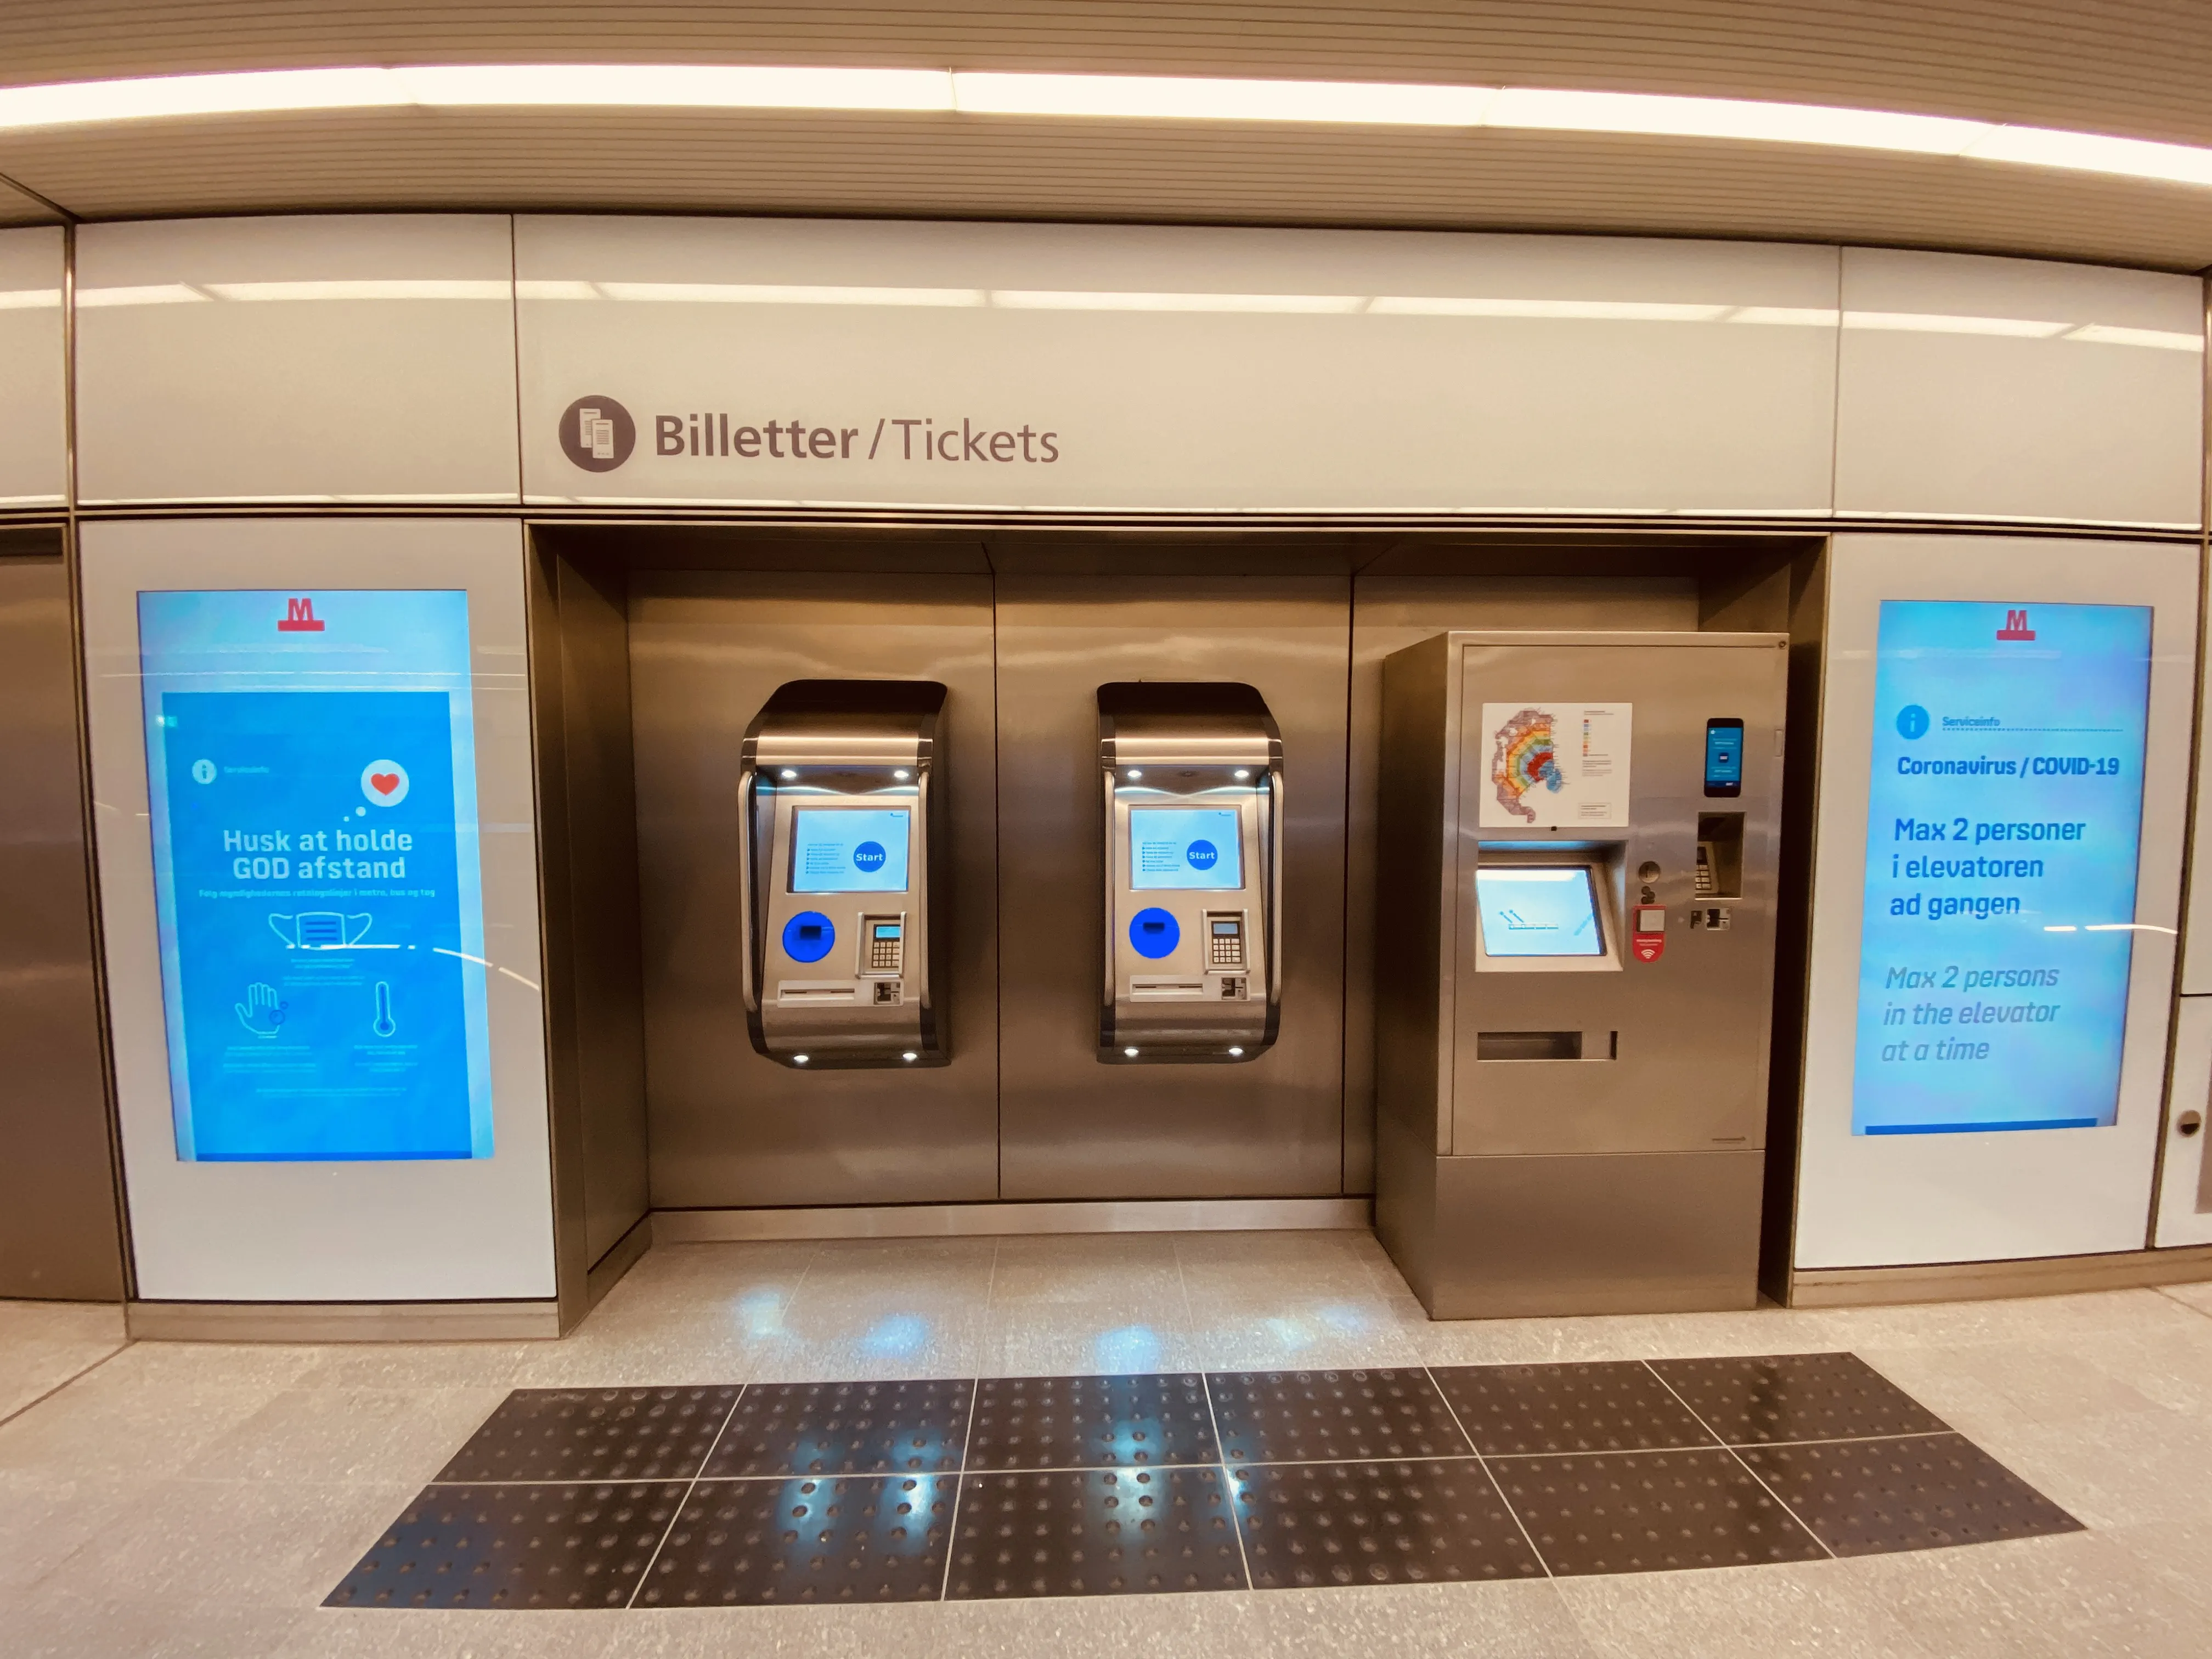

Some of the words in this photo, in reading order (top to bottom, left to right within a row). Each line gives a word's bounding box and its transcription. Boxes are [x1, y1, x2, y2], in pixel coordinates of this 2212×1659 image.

[655, 413, 859, 459] Billetter
[891, 417, 1059, 464] Tickets
[1897, 756, 2017, 775] Coronavirus
[2033, 757, 2120, 775] COVID-19
[224, 830, 291, 852] Husk
[299, 831, 328, 852] at
[336, 829, 413, 851] holde
[1894, 818, 1946, 841] Max
[1953, 817, 1969, 841] 2
[1975, 822, 2086, 845] personer
[856, 853, 883, 861] Start
[1189, 851, 1215, 860] Start
[1892, 854, 1899, 878] i
[1906, 855, 2044, 878] elevatoren
[233, 857, 290, 880] GOD
[298, 856, 405, 879] afstand
[1890, 893, 1921, 916] ad
[1928, 896, 2021, 921] gangen
[1885, 967, 1936, 989] Max
[1942, 966, 1959, 989] 2
[1963, 968, 2059, 992] persons
[1883, 1002, 1906, 1026] in
[1913, 1002, 1953, 1025] the
[1959, 1002, 2061, 1024] elevator
[1881, 1039, 1908, 1062] at
[1914, 1042, 1929, 1061] a
[1936, 1036, 1990, 1060] time
